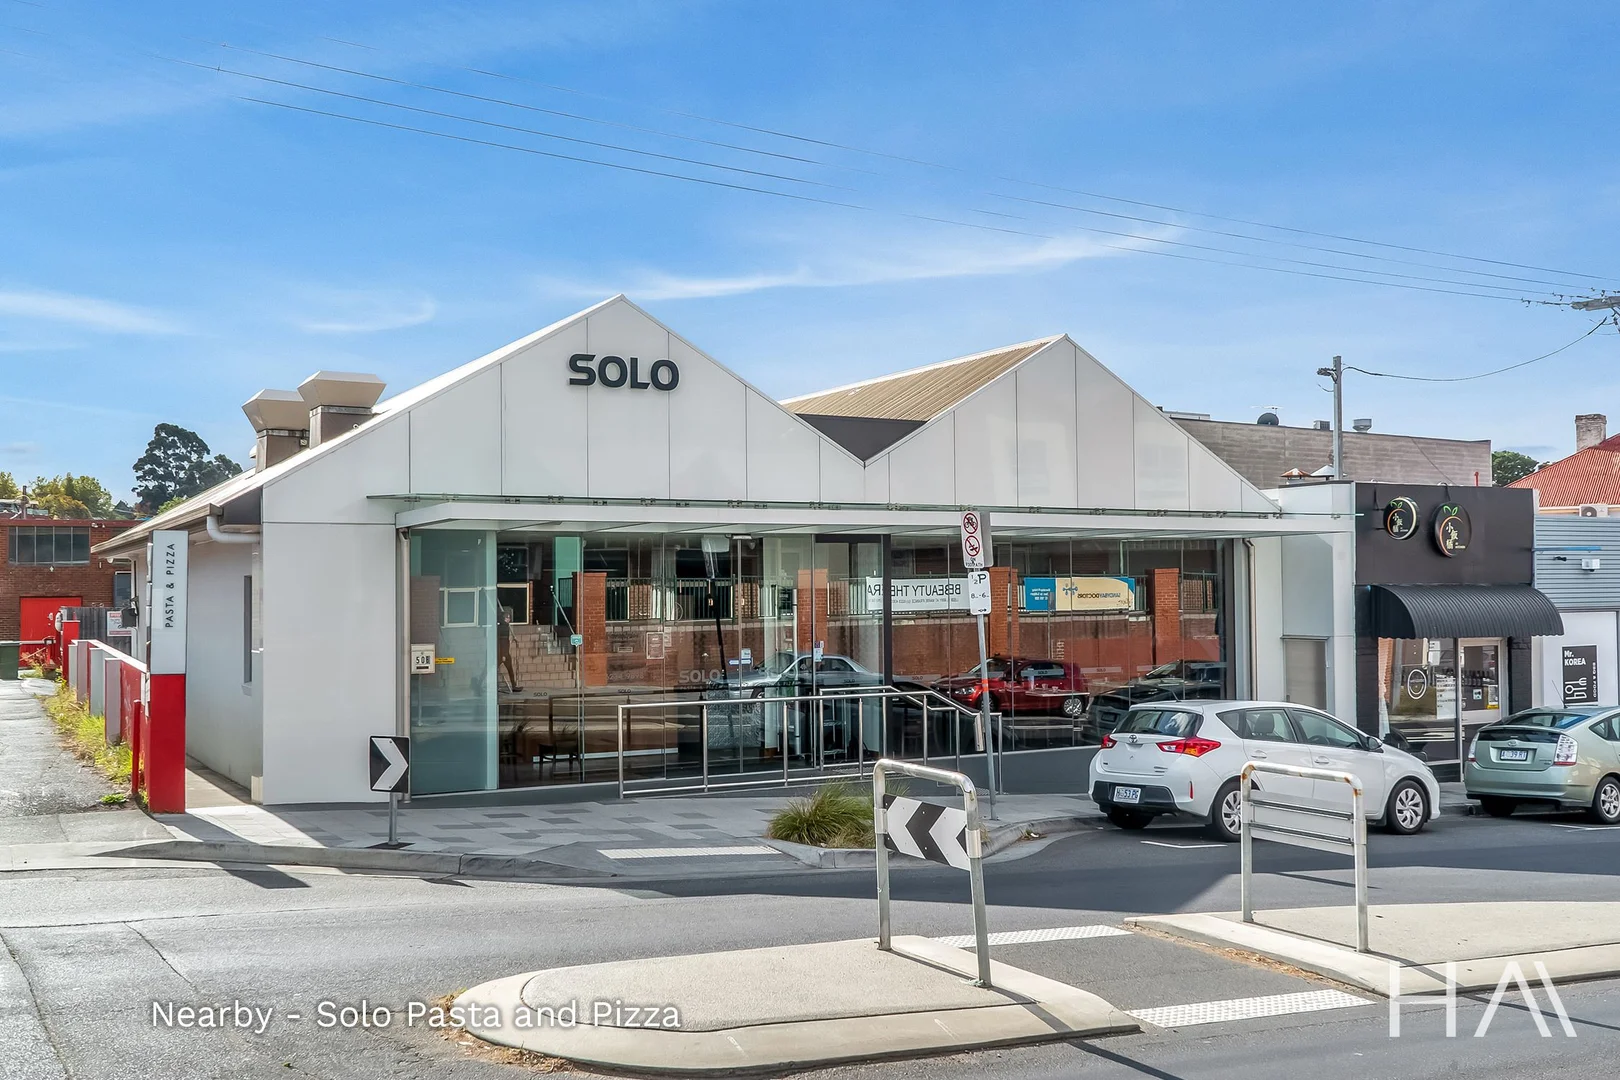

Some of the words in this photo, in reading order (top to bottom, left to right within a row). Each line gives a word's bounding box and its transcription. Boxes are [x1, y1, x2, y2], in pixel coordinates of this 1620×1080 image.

[568, 353, 681, 391] SOLO
[165, 542, 175, 576] PIZZA
[164, 595, 175, 628] PASTA
[1564, 658, 1587, 666] KOREA
